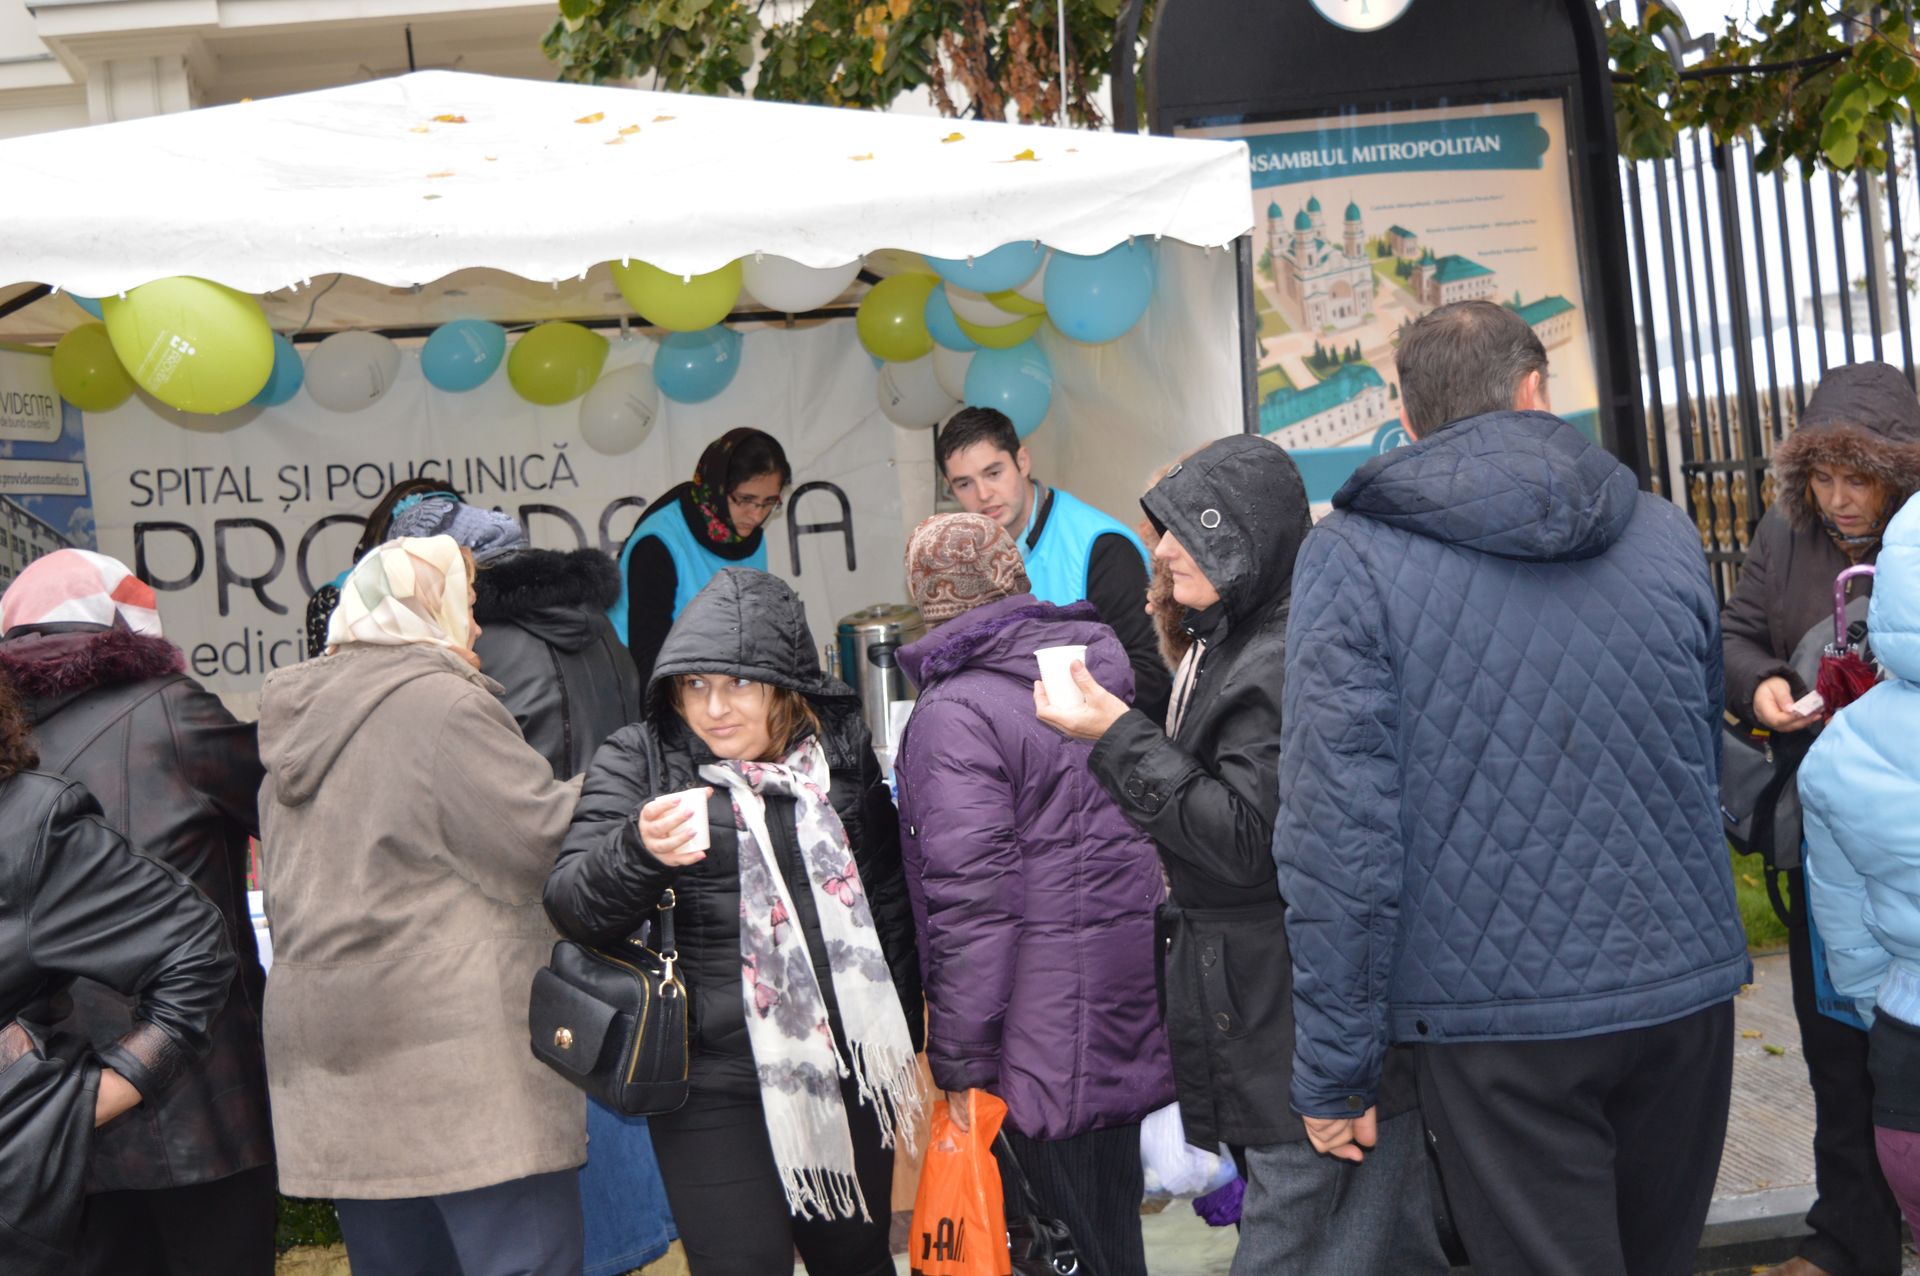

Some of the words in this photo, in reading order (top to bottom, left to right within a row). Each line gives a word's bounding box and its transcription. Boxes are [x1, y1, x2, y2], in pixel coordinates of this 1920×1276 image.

[1351, 135, 1501, 164] MITROPOLITAN
[129, 465, 264, 507] SPITAL
[278, 464, 310, 513] ȘI
